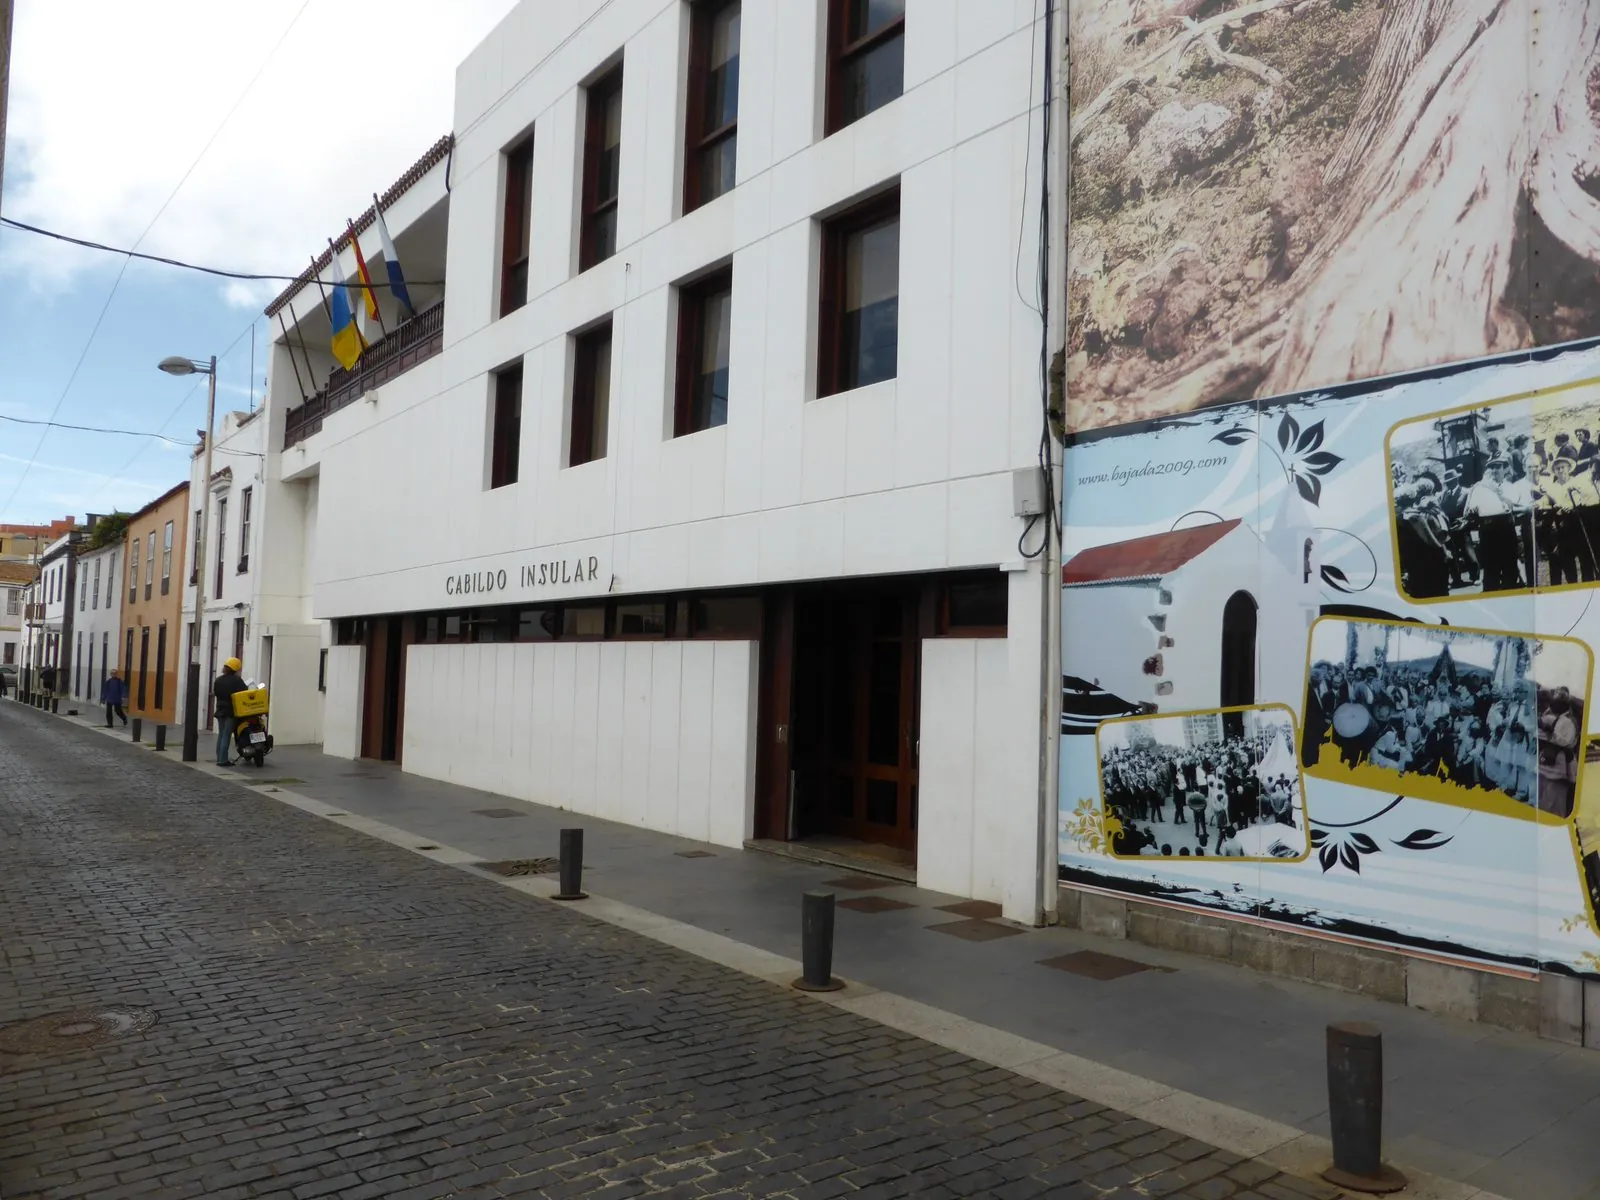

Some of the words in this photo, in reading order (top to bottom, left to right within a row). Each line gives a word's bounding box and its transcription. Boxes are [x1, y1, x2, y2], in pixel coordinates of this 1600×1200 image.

[1078, 456, 1228, 487] www.bajada2009.com
[446, 569, 507, 596] CABILDO
[520, 556, 599, 588] INSULAR
